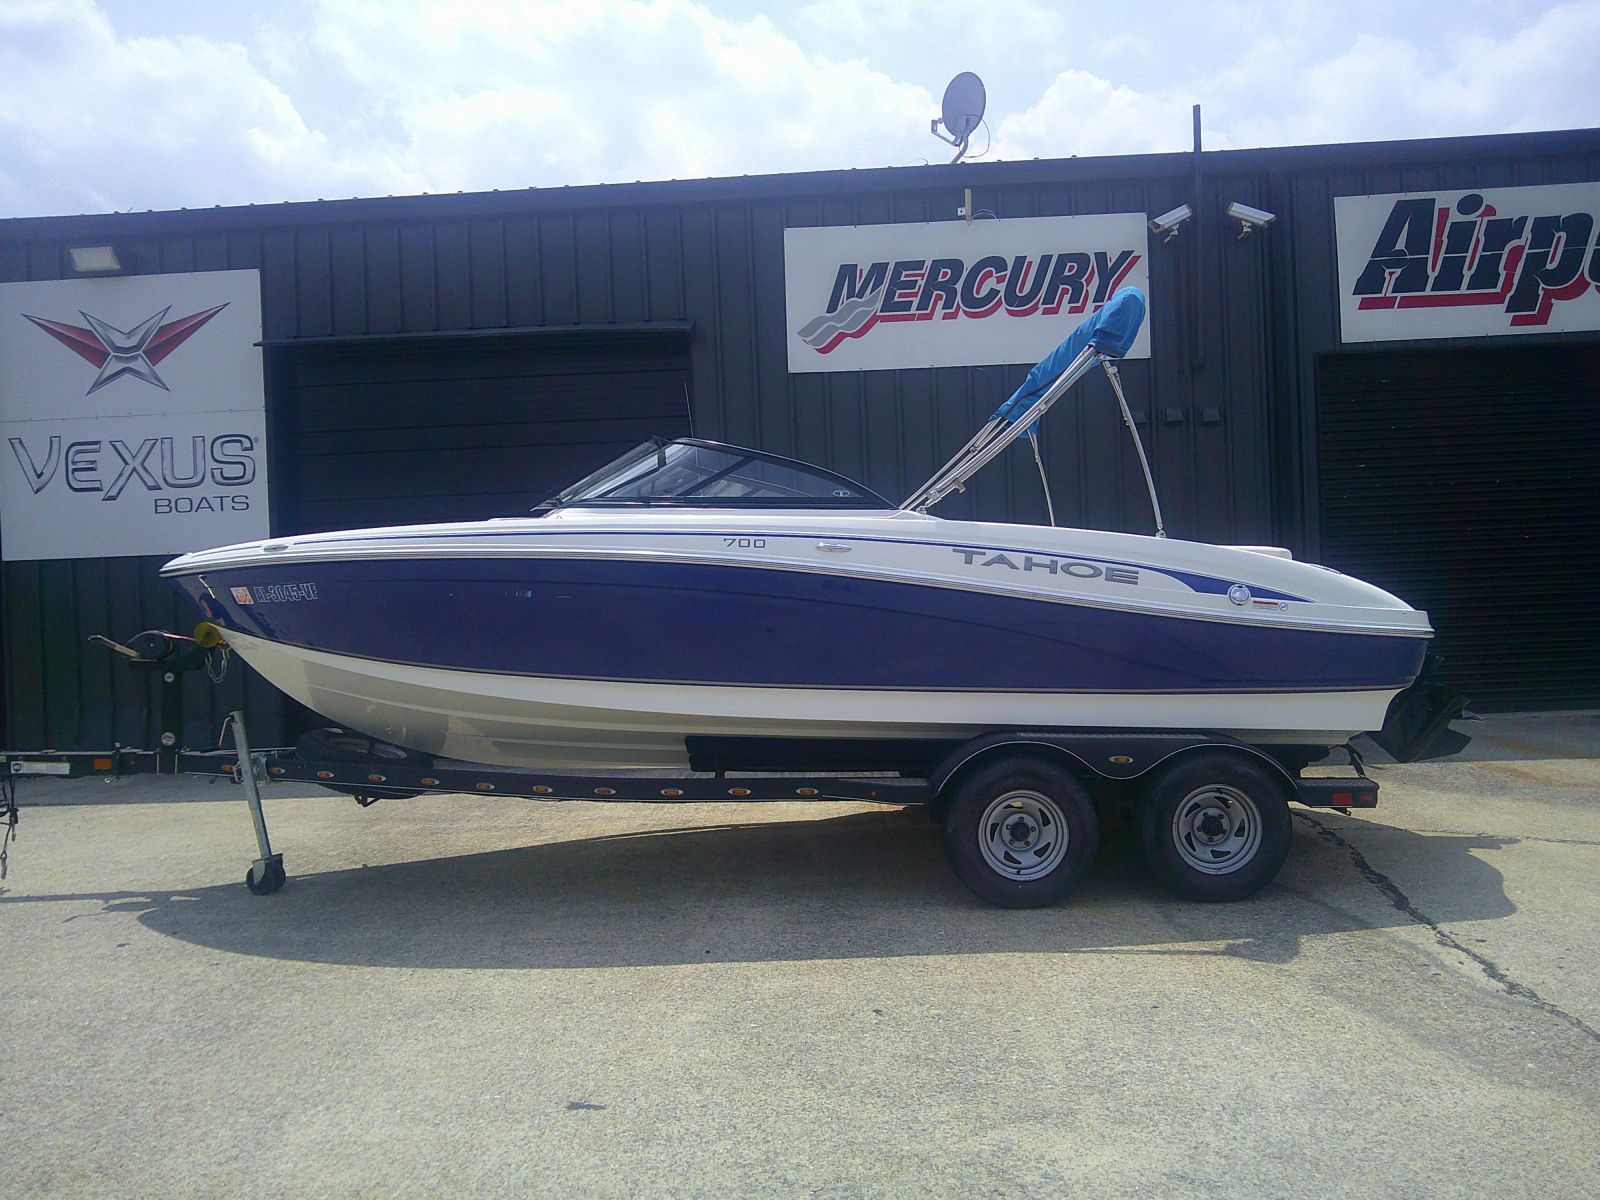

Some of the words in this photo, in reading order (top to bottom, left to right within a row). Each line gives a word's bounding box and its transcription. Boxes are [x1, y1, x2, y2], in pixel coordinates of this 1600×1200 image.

[826, 250, 1142, 322] MERCURY
[1352, 194, 1600, 326] Airp
[8, 433, 256, 501] VEXUS
[154, 495, 249, 514] BOATS
[723, 538, 766, 549] 700
[952, 548, 1139, 586] TAHOE
